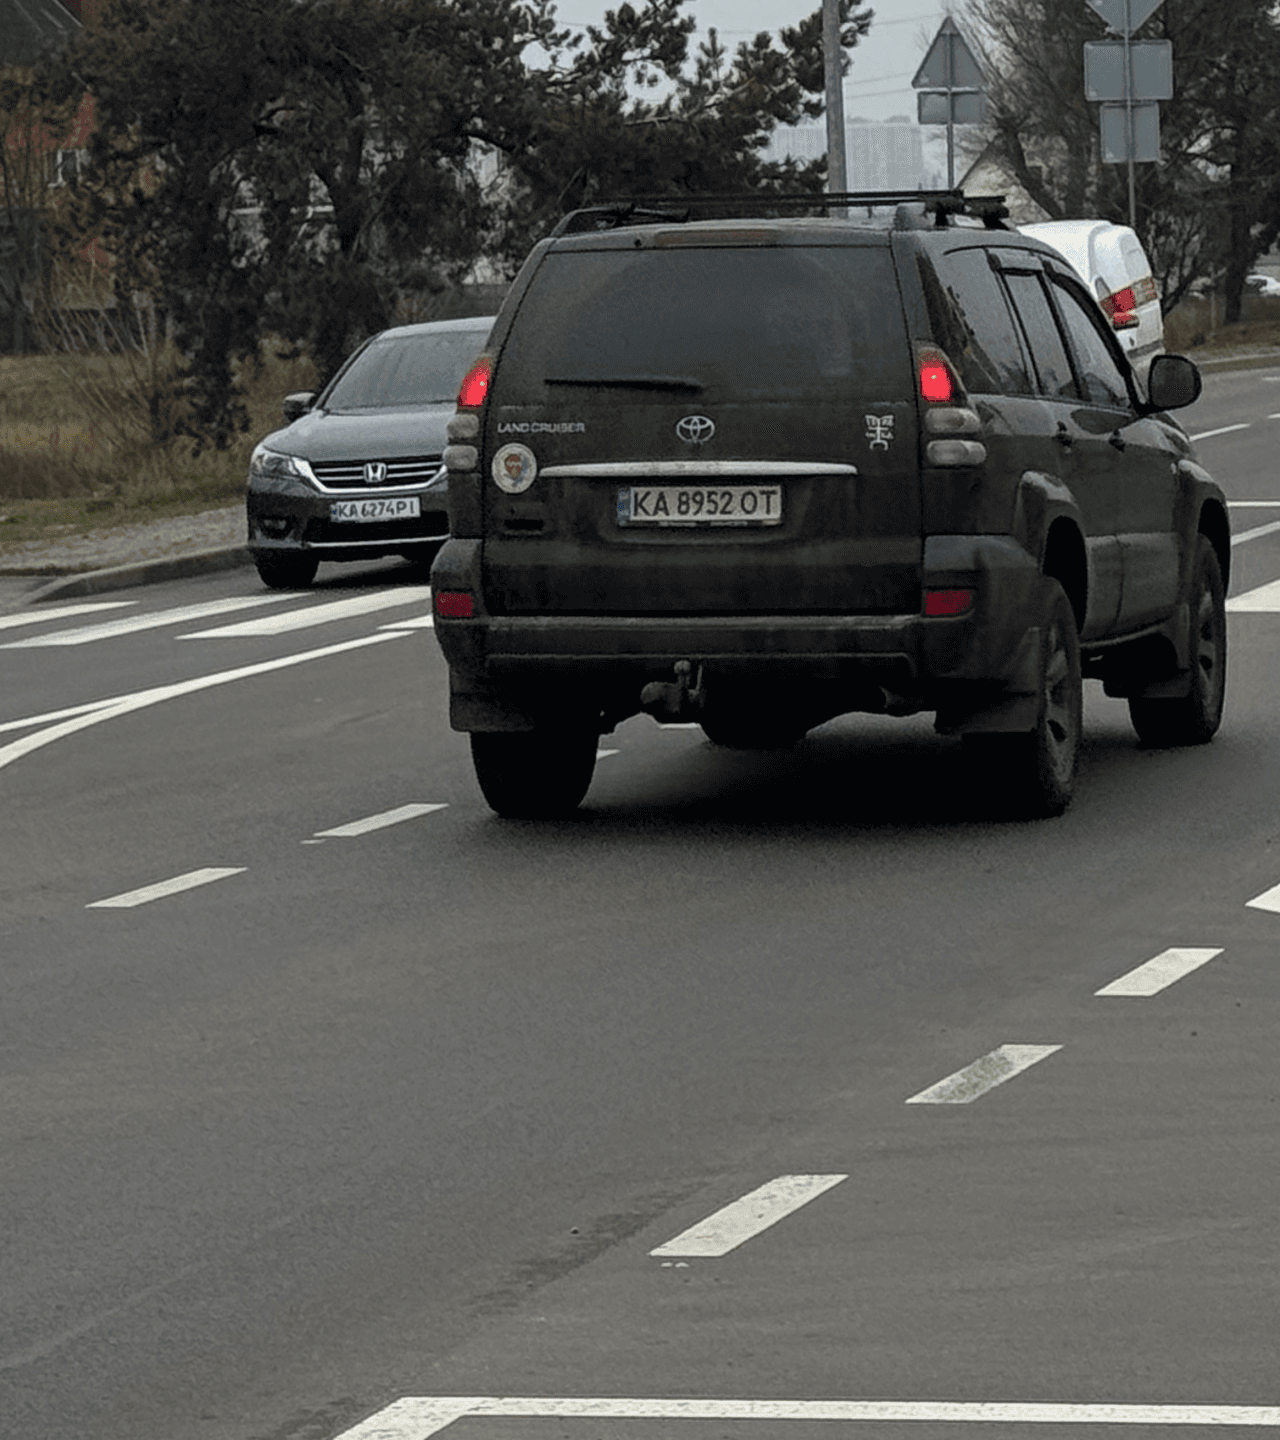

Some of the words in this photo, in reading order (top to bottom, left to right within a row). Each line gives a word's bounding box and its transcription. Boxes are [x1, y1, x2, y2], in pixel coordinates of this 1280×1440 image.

[497, 422, 530, 434] LAND
[531, 422, 586, 434] CRUISER
[337, 503, 359, 519] KA
[360, 501, 395, 518] 6274
[396, 500, 416, 515] PI
[633, 490, 671, 517] KA
[677, 490, 734, 516] 8952
[740, 489, 779, 516] OT
